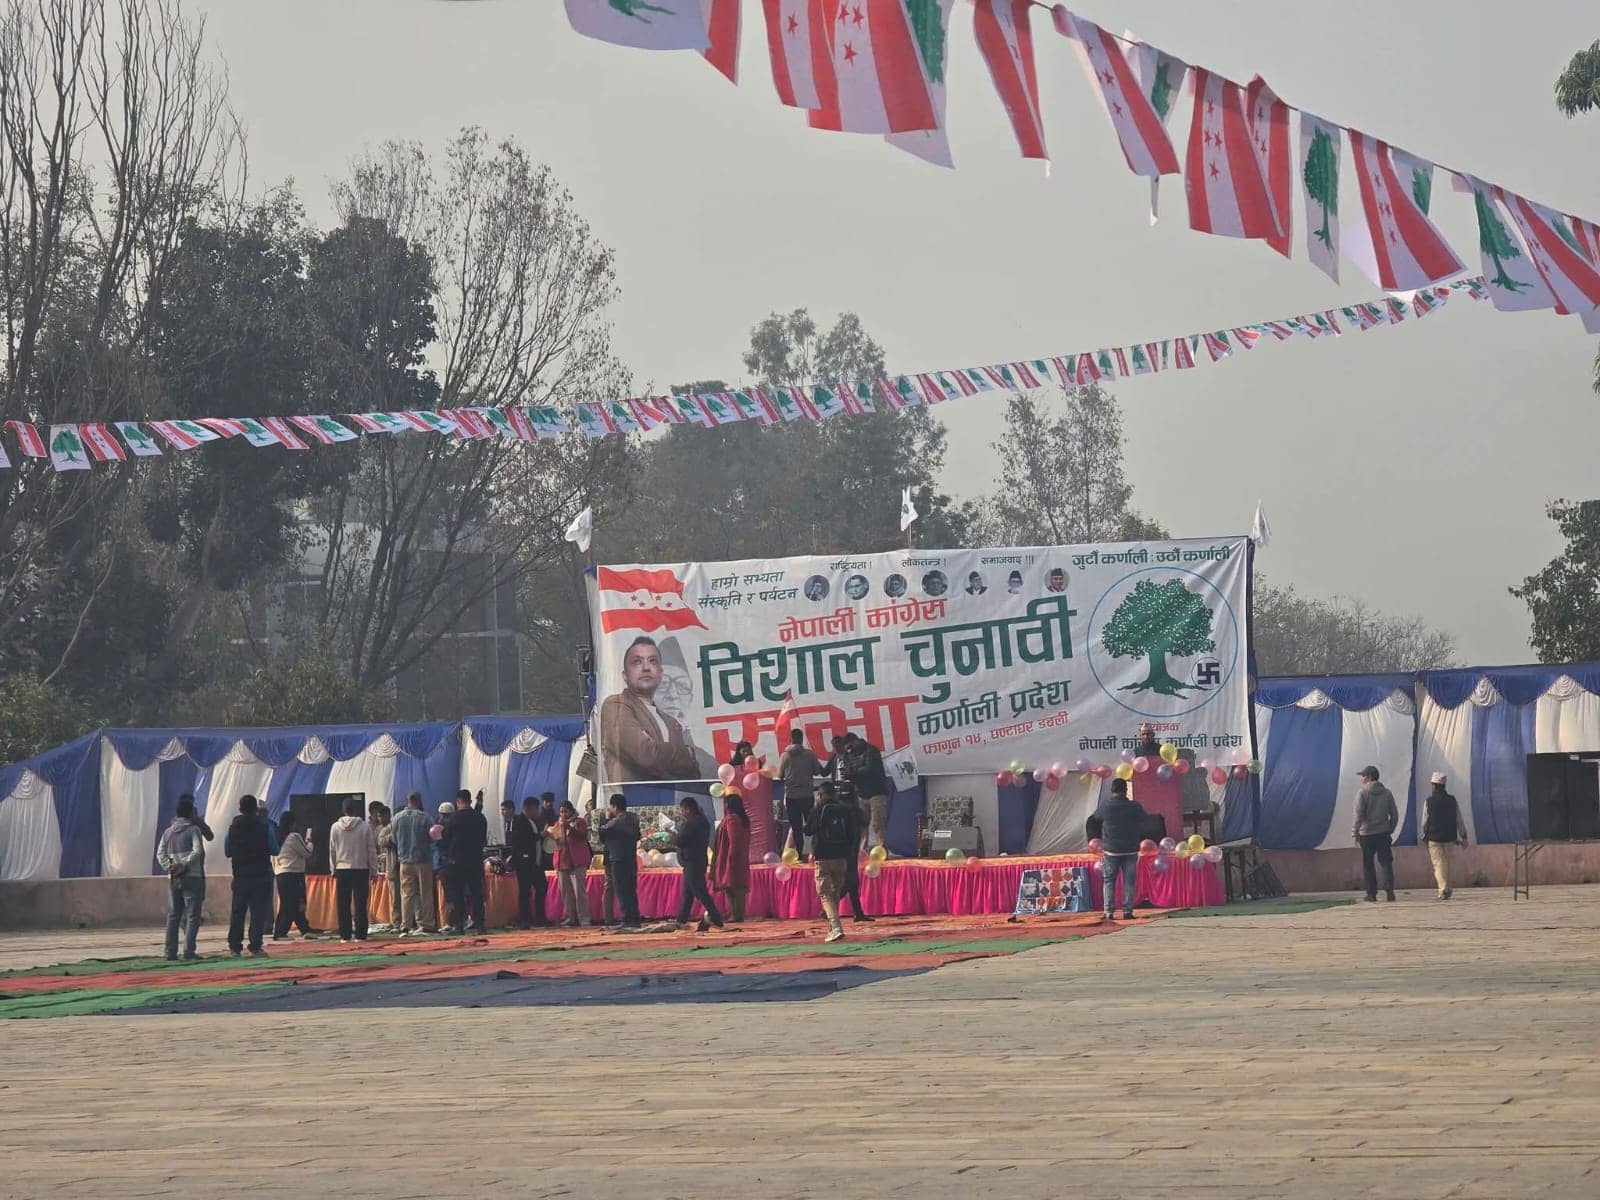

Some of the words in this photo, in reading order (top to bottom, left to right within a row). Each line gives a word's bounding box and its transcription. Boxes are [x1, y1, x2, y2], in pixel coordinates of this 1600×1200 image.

[981, 555, 1022, 565] समाजवाद
[1100, 548, 1148, 565] कर्णाली
[1182, 545, 1230, 562] कर्णाली
[711, 572, 739, 591] हाम्रो
[743, 571, 785, 586] सभ्यता
[698, 590, 742, 610] संस्कृति
[747, 593, 756, 605] र
[778, 606, 857, 644] नेपाली
[865, 597, 948, 628] कांग्रेस
[697, 636, 880, 708] विशाल
[900, 595, 1077, 704] चुनावी
[916, 695, 1001, 737] कर्णाली
[1010, 679, 1072, 718] प्रदेश
[923, 737, 961, 755] फागुन
[990, 721, 1034, 739] घण्टाघर
[1037, 711, 1069, 729] डबली
[1079, 735, 1117, 751] नेपाली
[1212, 733, 1243, 750] प्रदेश
